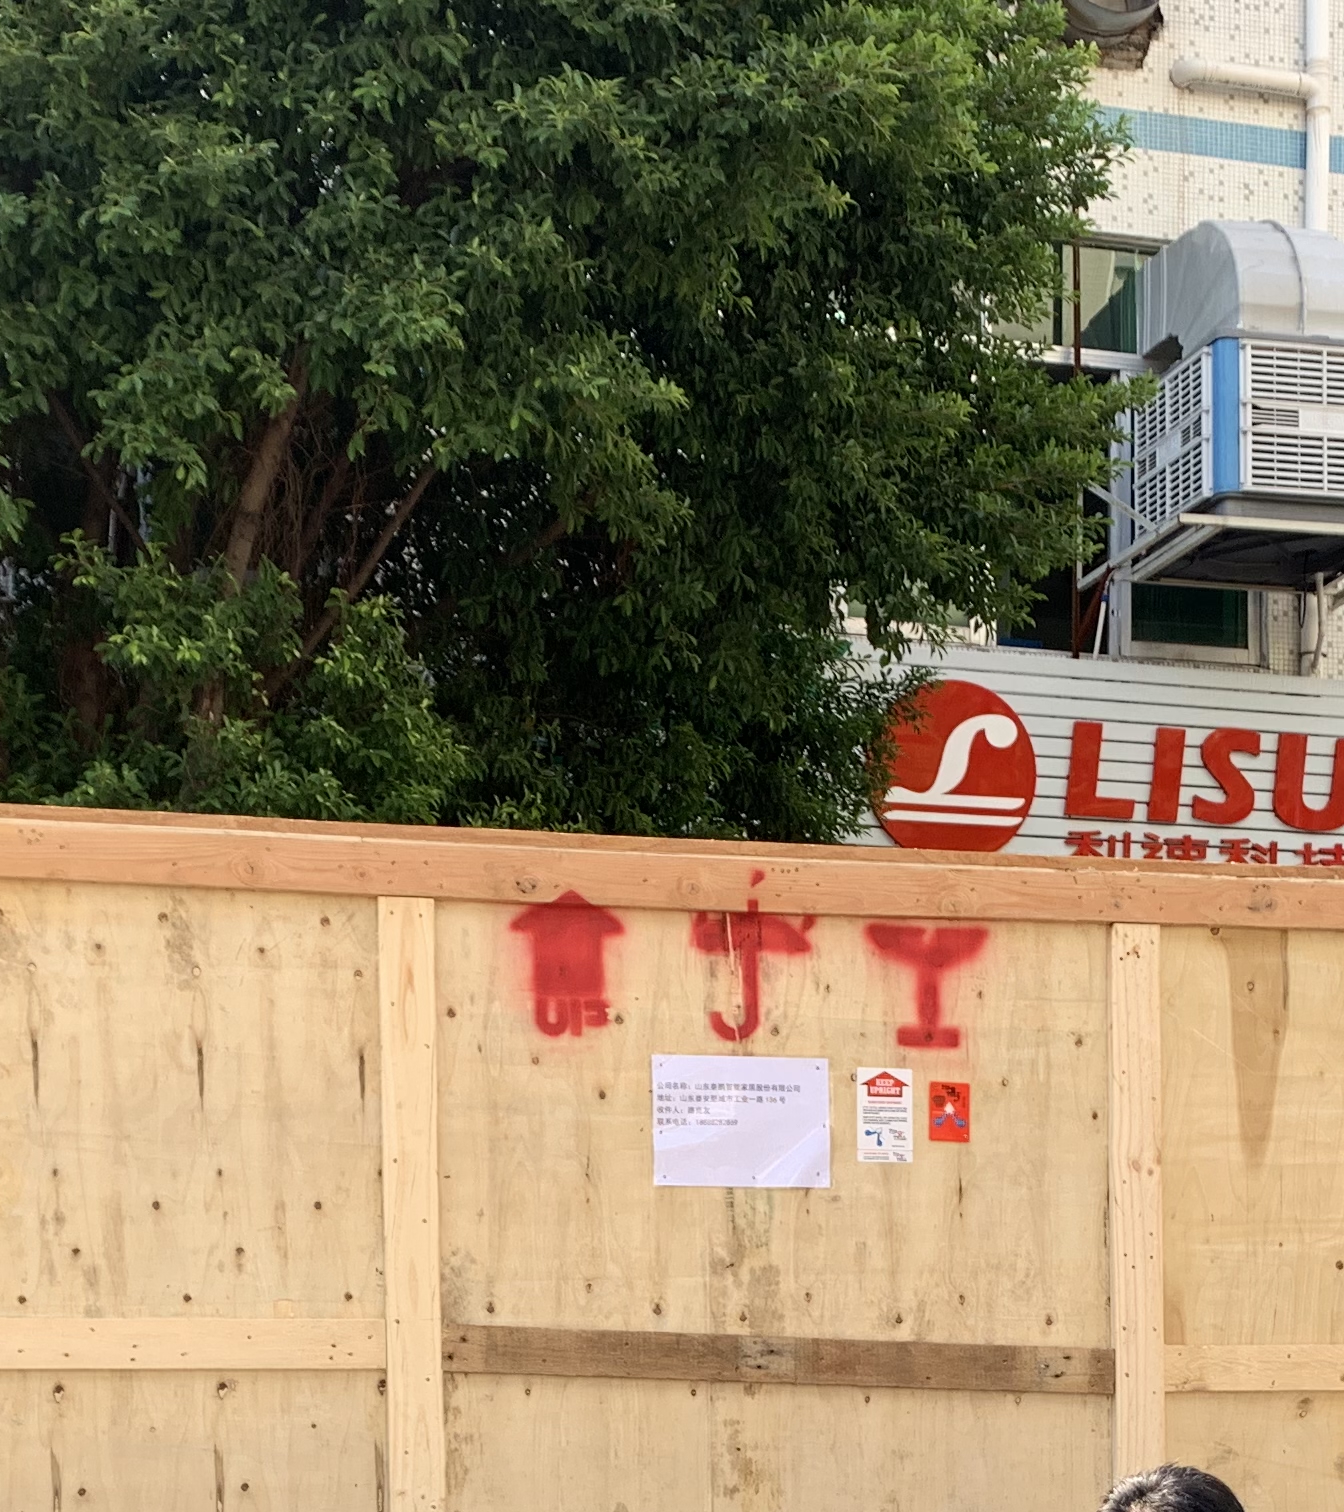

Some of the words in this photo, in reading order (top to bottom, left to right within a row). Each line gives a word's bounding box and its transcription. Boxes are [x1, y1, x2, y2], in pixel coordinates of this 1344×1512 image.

[535, 997, 610, 1038] UP
[876, 1078, 894, 1087] KEEP
[869, 1086, 900, 1095] UPRIGHT
